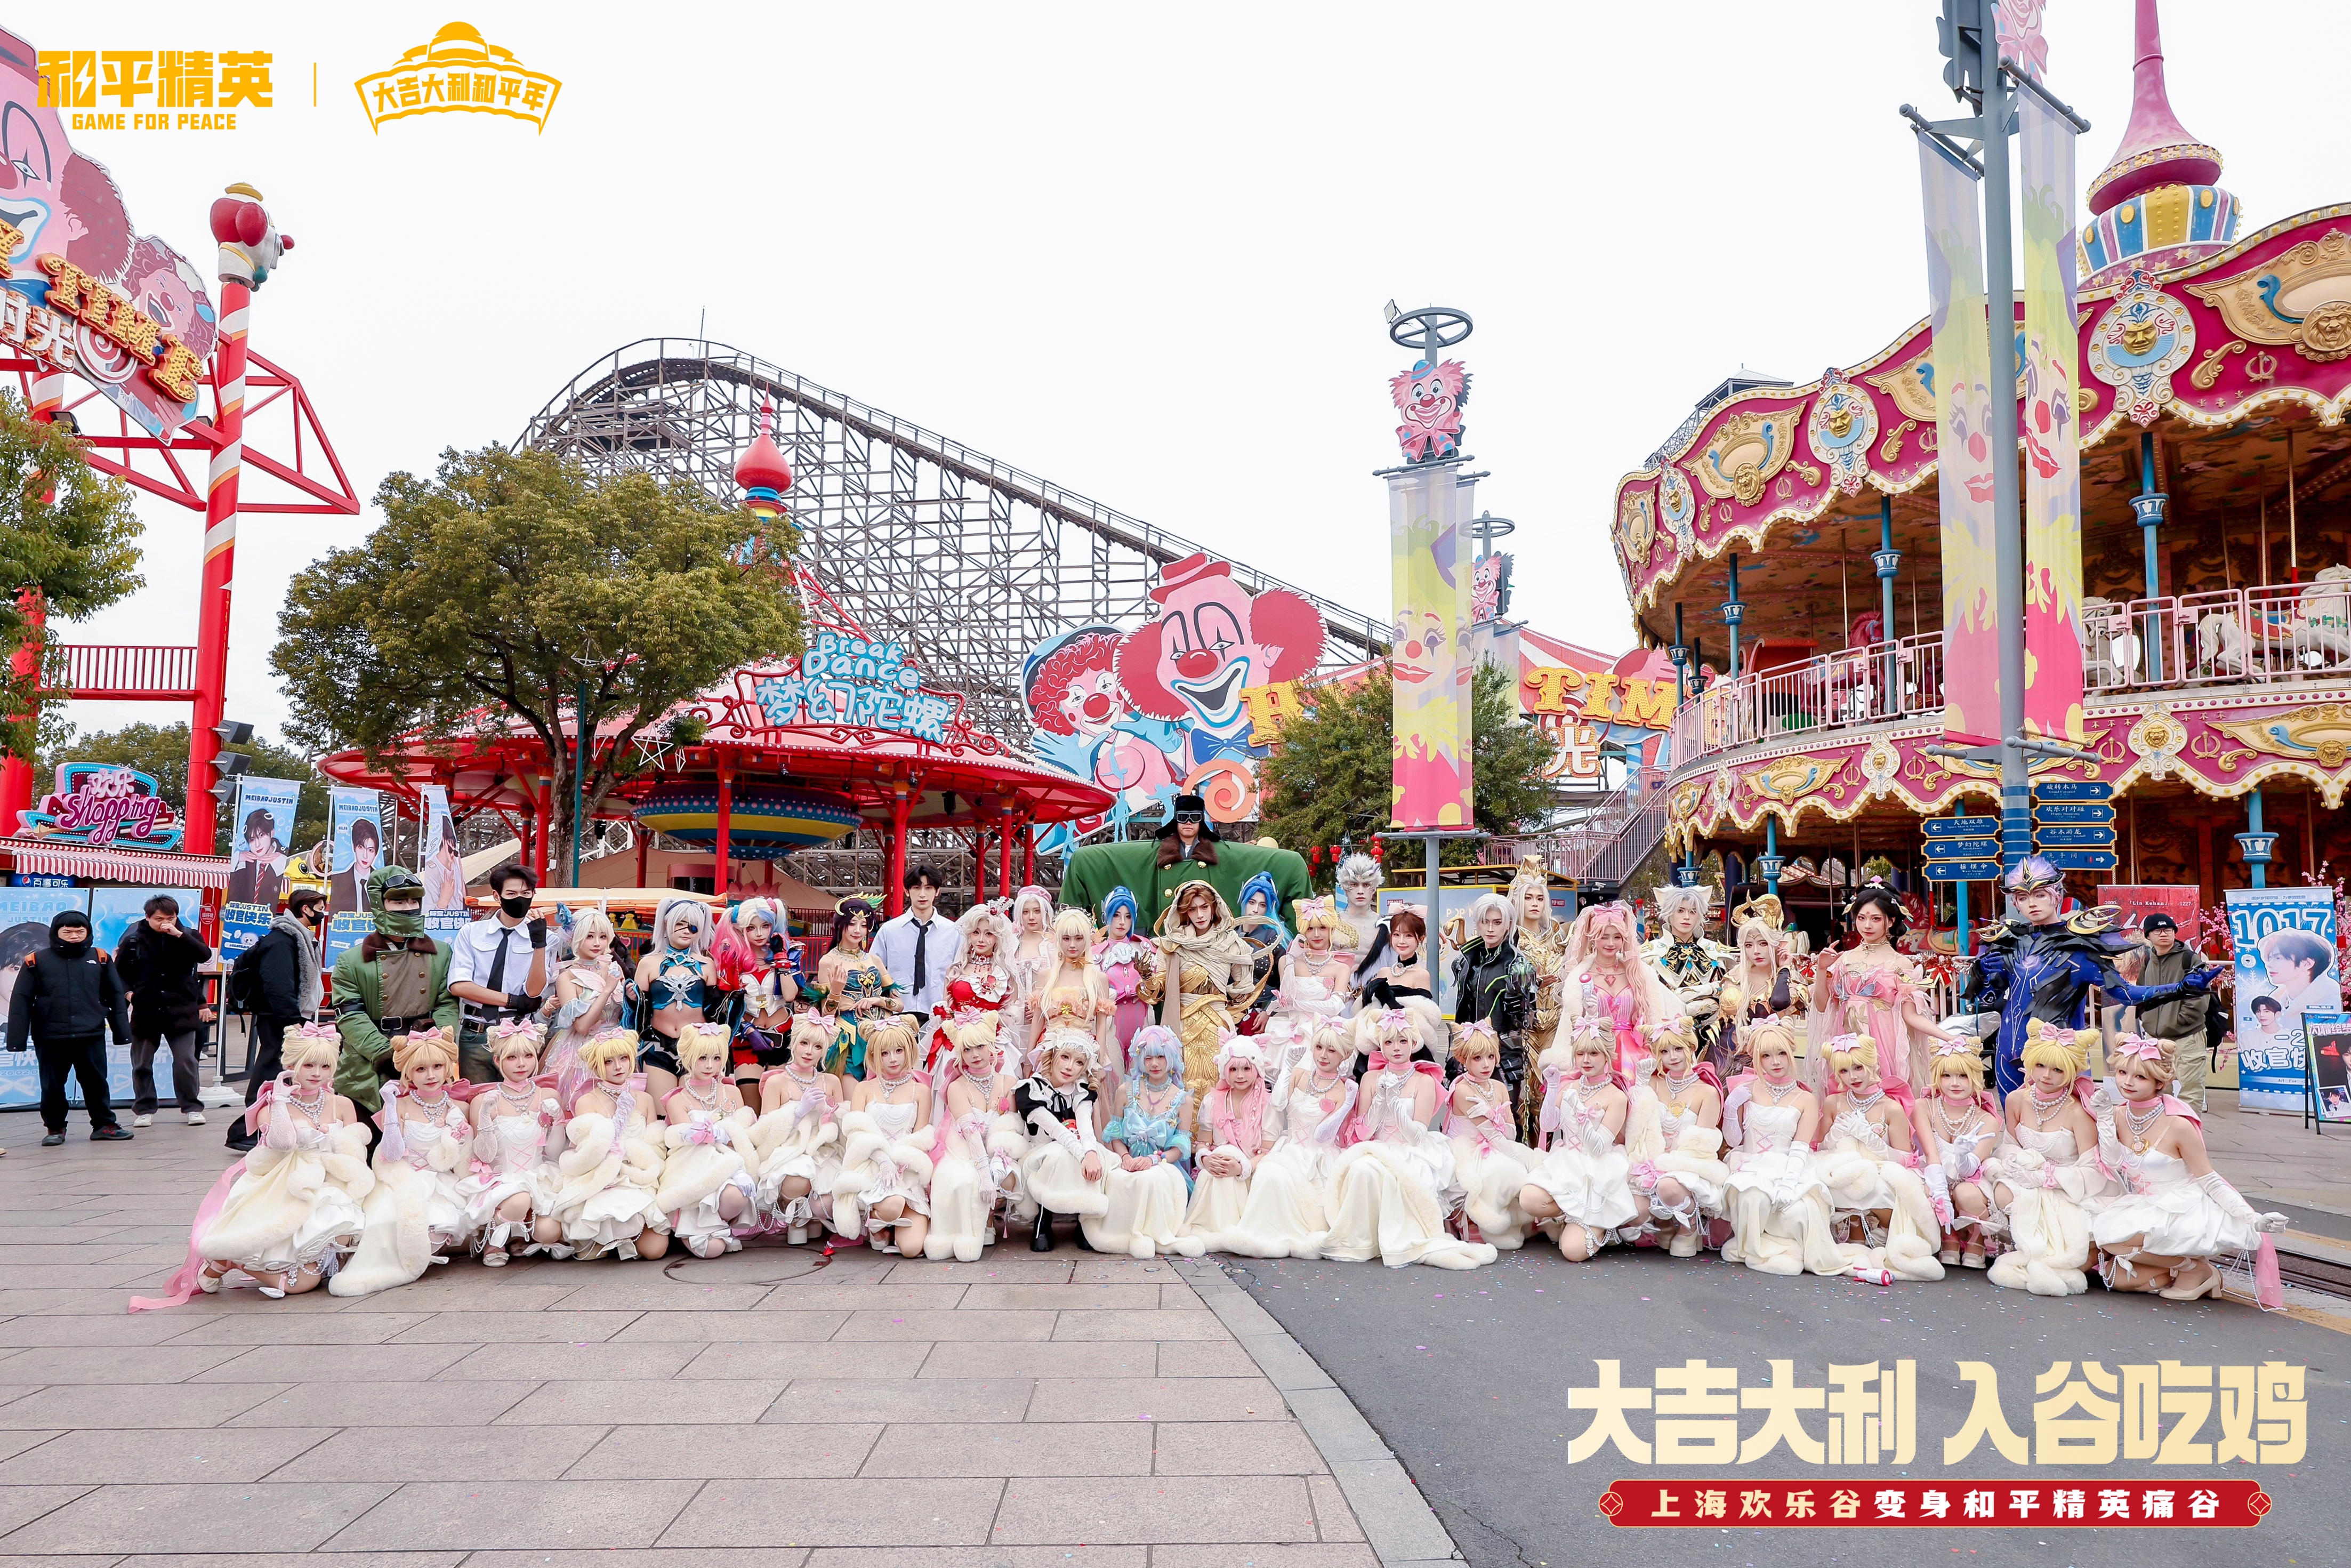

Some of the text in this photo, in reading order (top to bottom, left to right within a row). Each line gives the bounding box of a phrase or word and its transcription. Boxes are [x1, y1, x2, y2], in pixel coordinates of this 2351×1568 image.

[36, 252, 204, 403] TIME
[802, 647, 921, 690] Dance
[814, 632, 905, 663] Break
[755, 676, 951, 743] 梦幻陀螺
[87, 768, 136, 798] 欢乐
[55, 785, 161, 844] Shopping
[33, 878, 68, 888] 百事可乐
